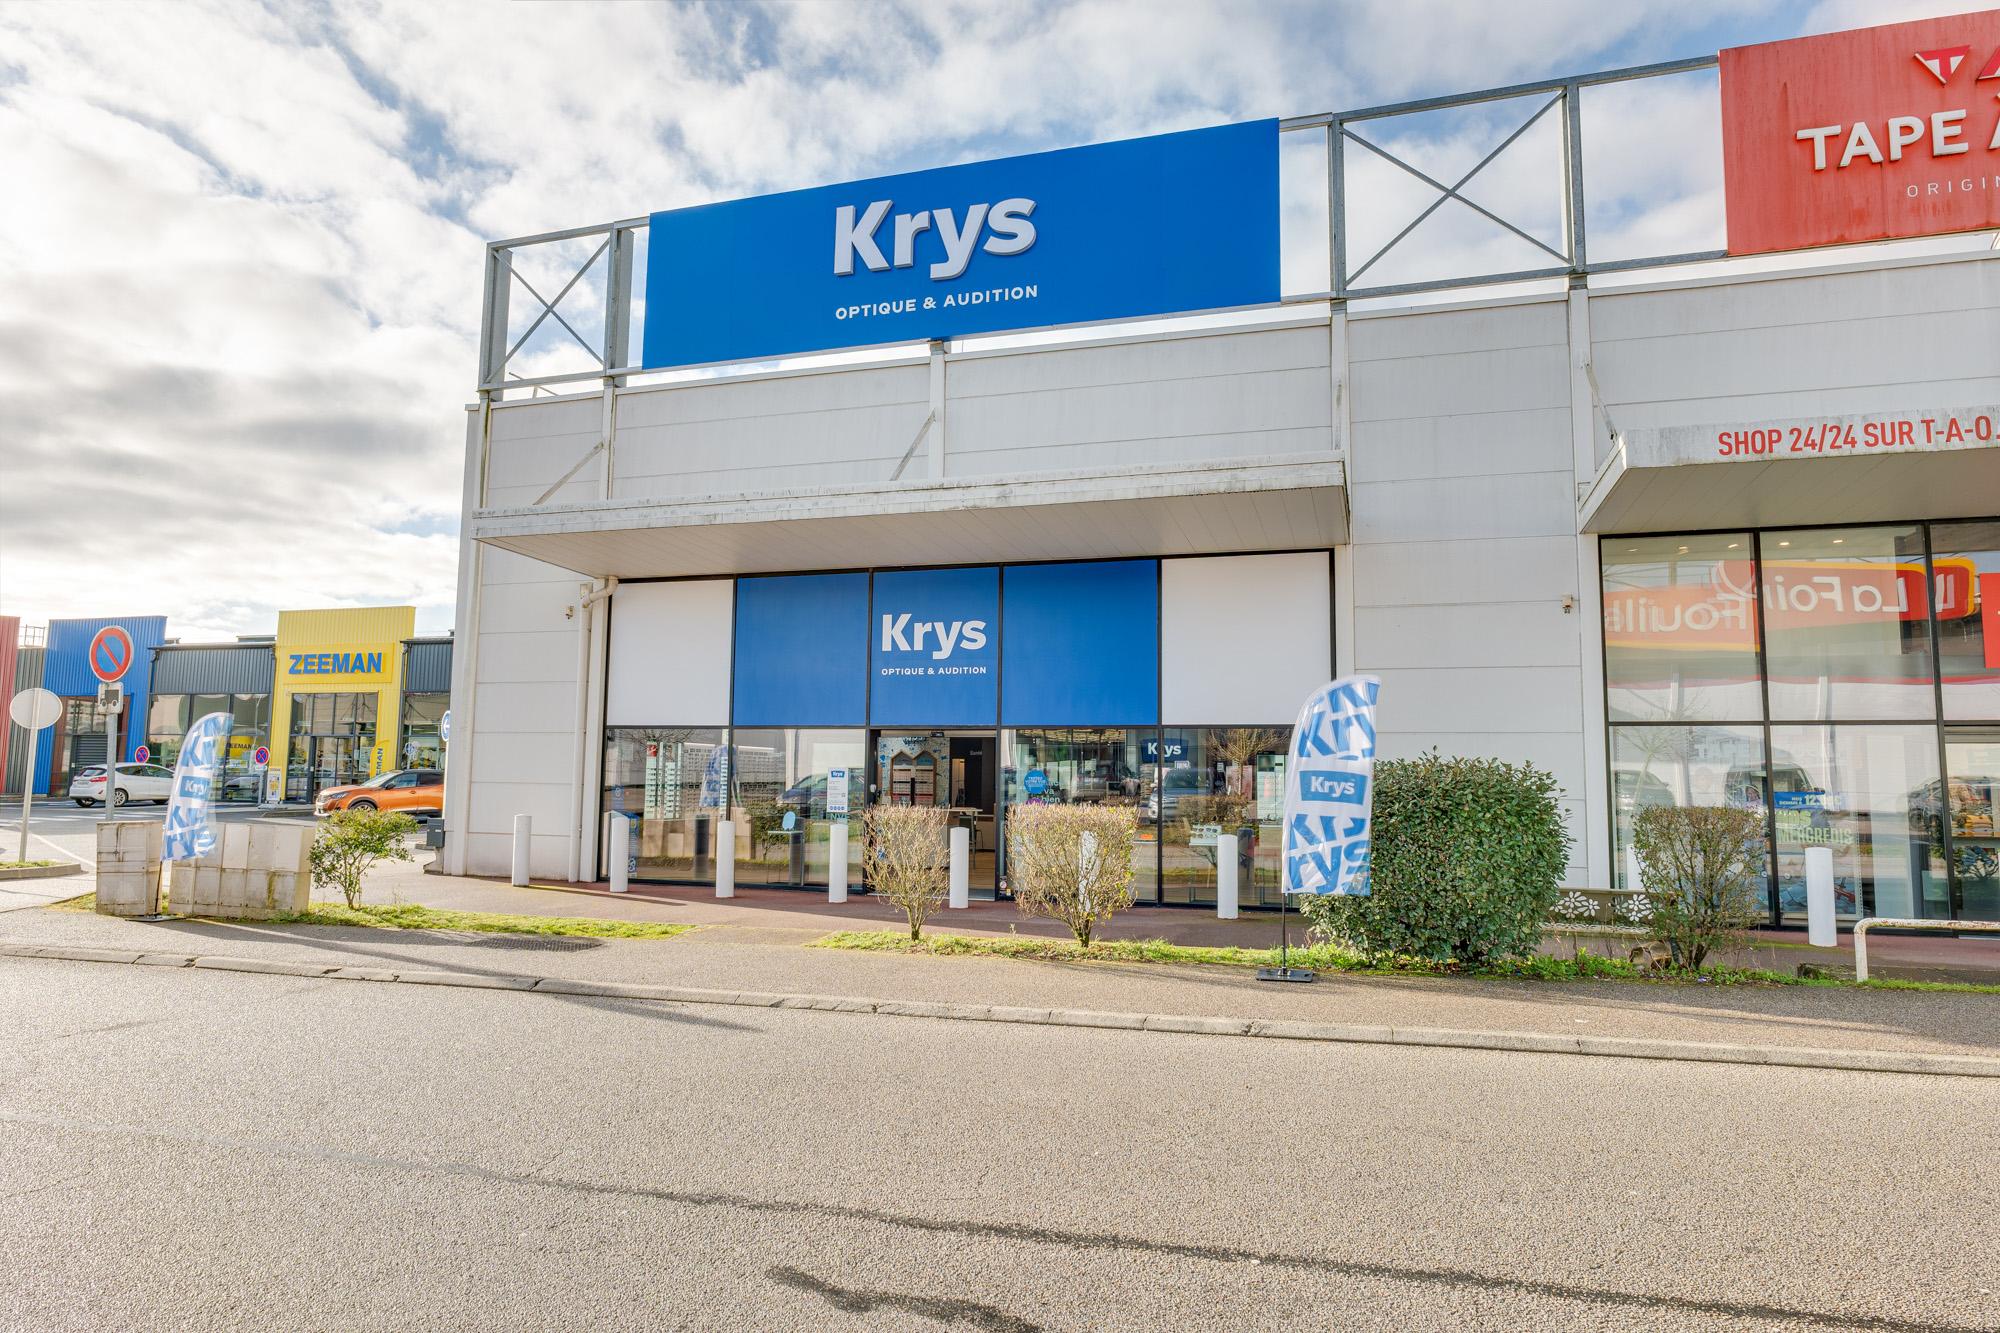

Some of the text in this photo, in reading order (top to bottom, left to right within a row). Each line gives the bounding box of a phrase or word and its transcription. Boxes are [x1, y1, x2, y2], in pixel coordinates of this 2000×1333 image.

[1796, 109, 1969, 171] TAPE
[833, 198, 1037, 281] Krys
[835, 285, 1038, 320] OPTIQUE & AUDITION
[1718, 429, 1782, 456] SHOP
[1789, 423, 1857, 452] 24/24
[1863, 420, 1914, 447] SUR
[881, 613, 987, 660] Krys
[288, 652, 383, 674] ZEEMAN
[881, 666, 987, 675] OPTIQUE & AUDITION
[226, 742, 252, 751] EEMAN
[1147, 742, 1181, 758] Kys
[1310, 775, 1356, 798] Krys
